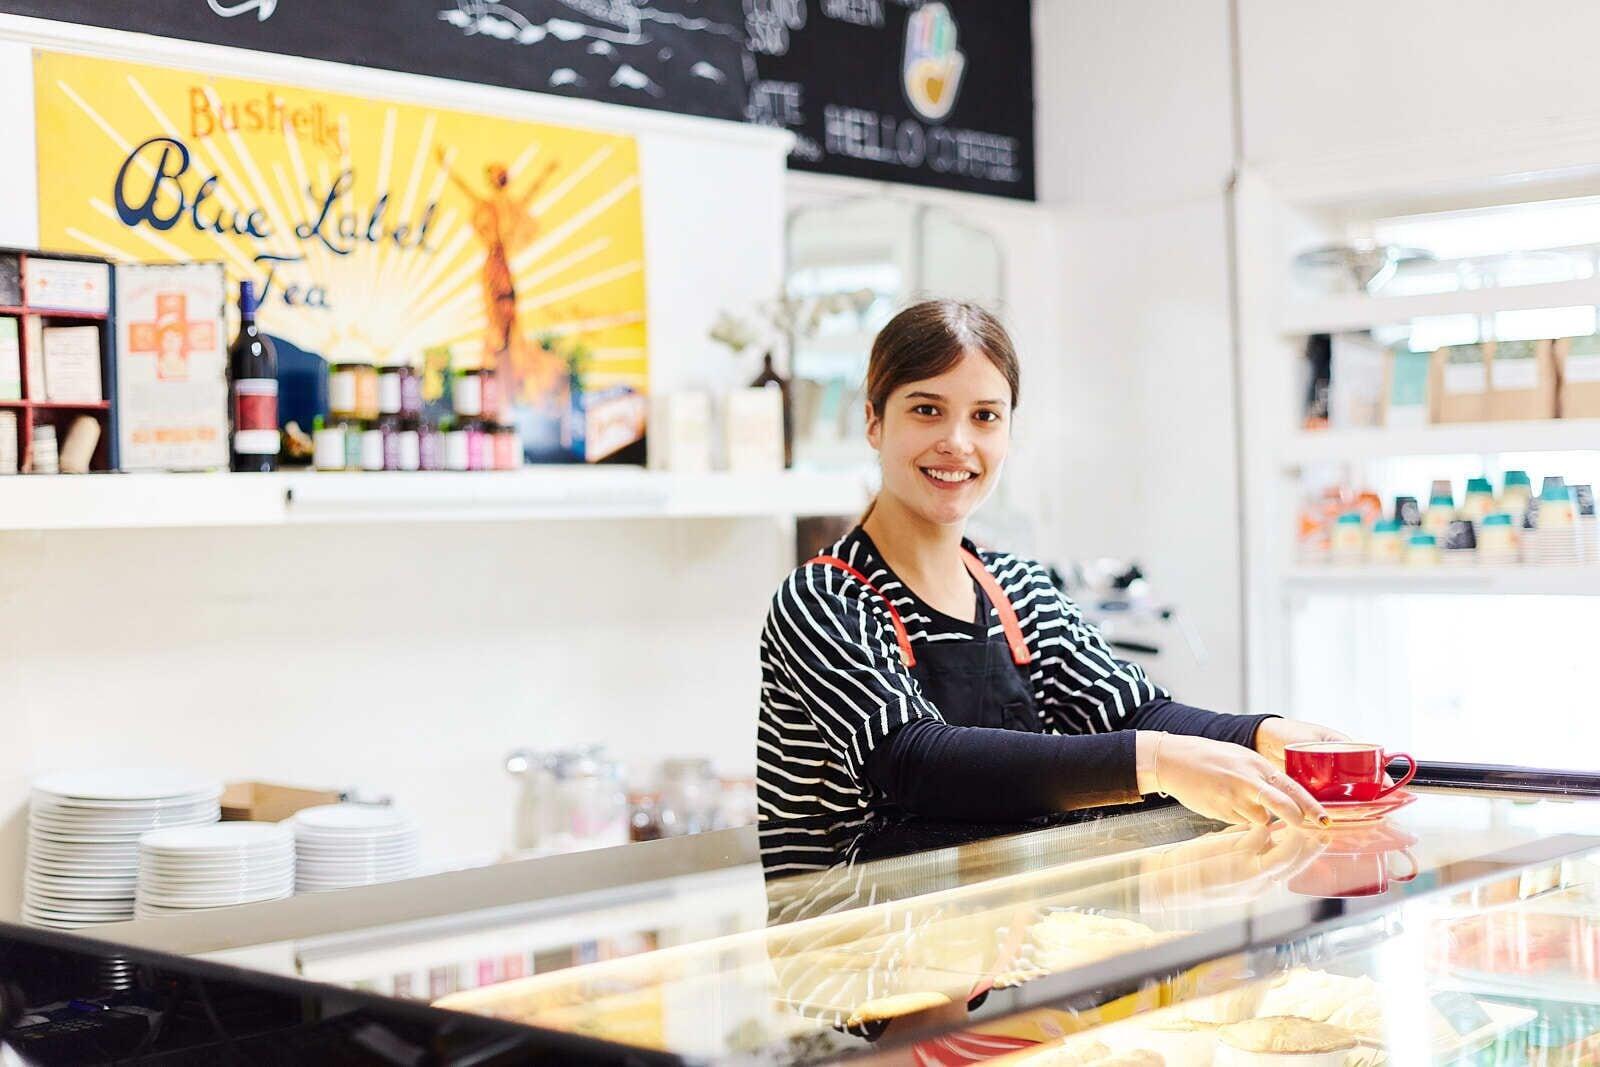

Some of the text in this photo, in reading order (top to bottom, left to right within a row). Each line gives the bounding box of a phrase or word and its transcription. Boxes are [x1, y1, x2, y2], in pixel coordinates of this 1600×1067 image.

[824, 104, 927, 168] HELLO
[113, 136, 438, 255] Blue Label
[248, 254, 332, 310] Tea
